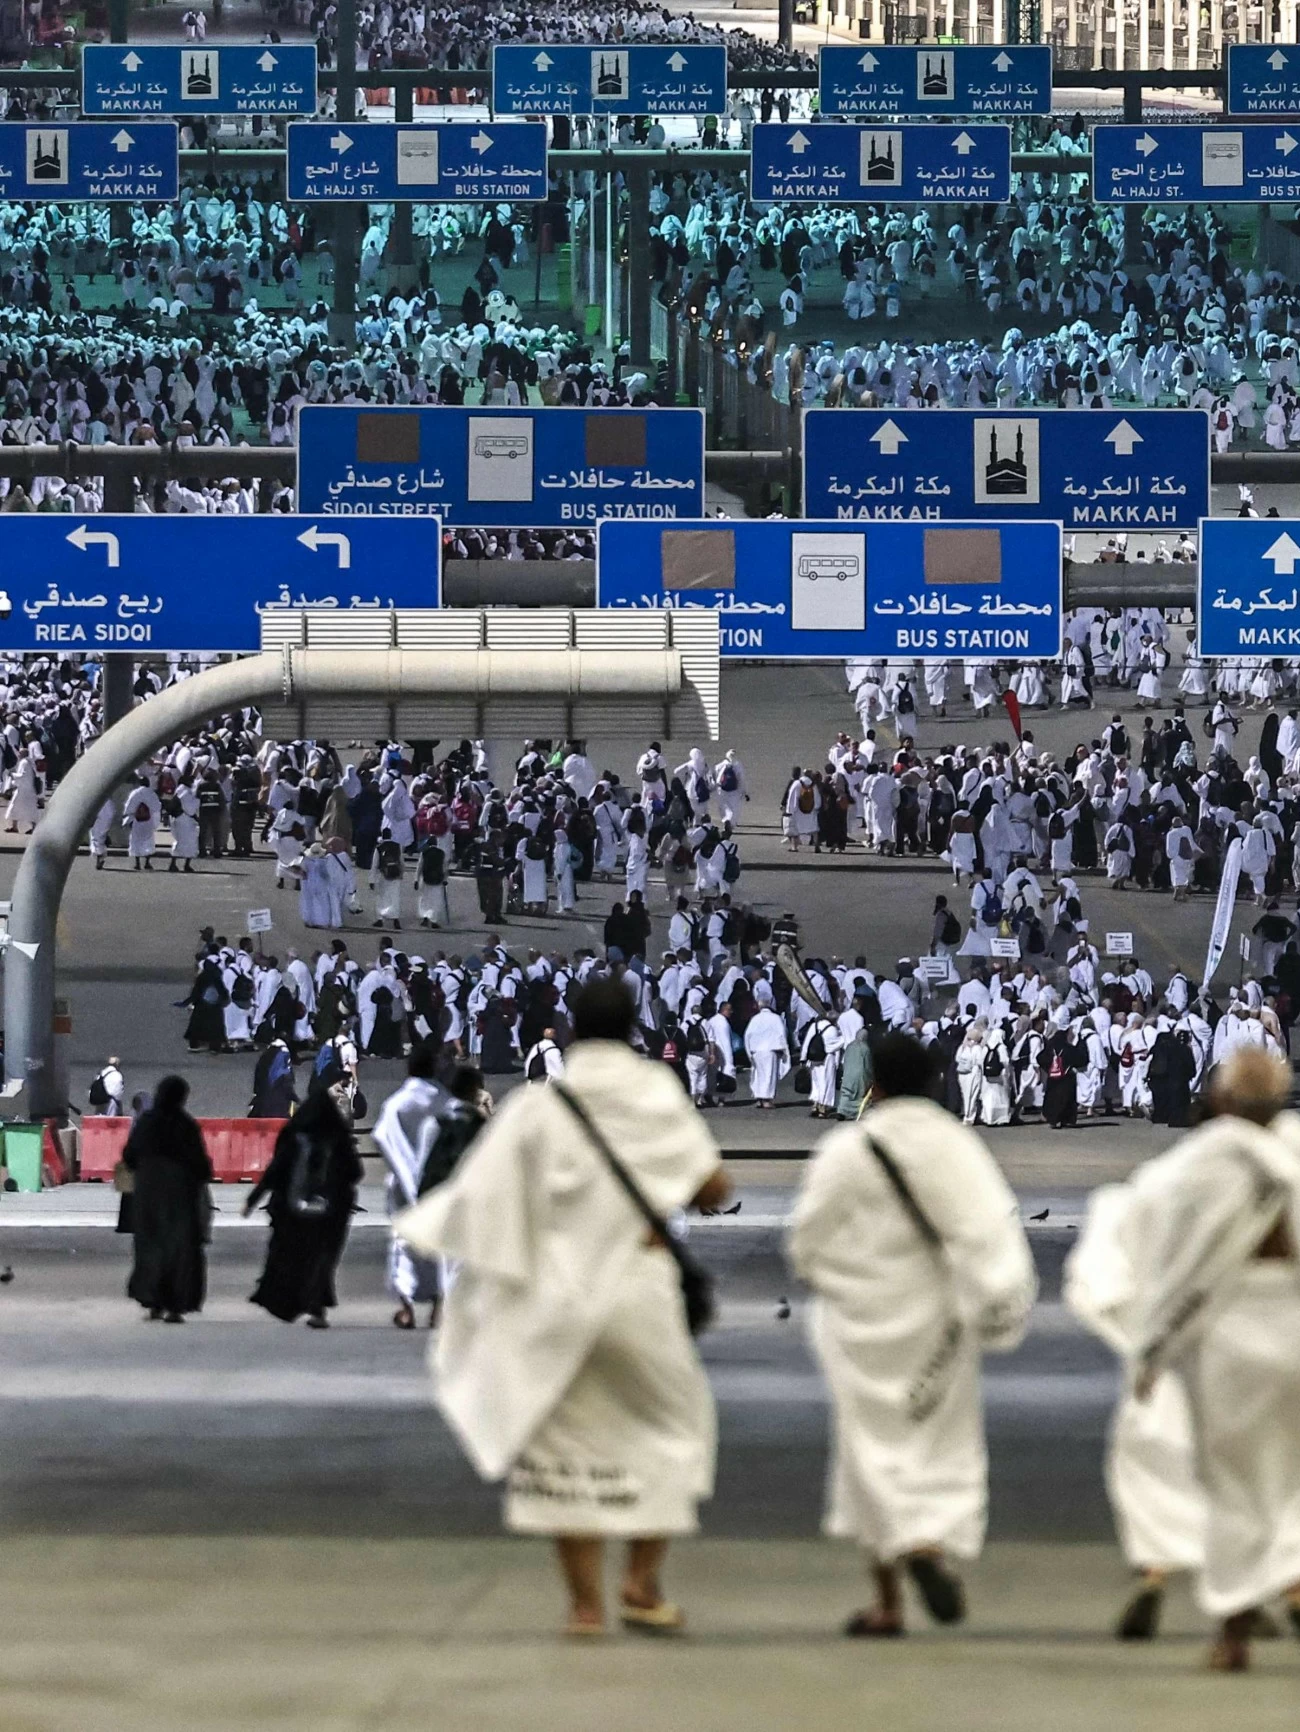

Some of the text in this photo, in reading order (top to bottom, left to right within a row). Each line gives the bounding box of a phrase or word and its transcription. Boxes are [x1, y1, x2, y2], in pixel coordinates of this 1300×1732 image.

[97, 83, 167, 96] مكة المكرمة
[232, 83, 303, 96] مكة المكرمة
[507, 84, 577, 97] مكة المكرمة
[642, 84, 712, 97] مكة المكرمة
[833, 84, 903, 97] مكة المكرمة
[968, 83, 1038, 97] مكة المكرمة
[1243, 83, 1286, 96] المكرمة
[102, 100, 161, 109] MAKKAH
[238, 100, 297, 109] MAKKAH
[513, 100, 571, 111] MAKKAH
[648, 101, 706, 110] MAKKAH
[839, 101, 897, 110] MAKKAH
[973, 100, 1032, 110] MAKKAH
[83, 165, 162, 179] مكة المكرمة
[306, 162, 379, 179] شارع الحج
[442, 164, 542, 176] محطة حافلات
[768, 166, 845, 180] مكة المكرمة
[917, 167, 995, 181] مكة المكرمة
[1112, 163, 1184, 179] شارع الحج
[1248, 165, 1300, 178] حافلات
[90, 184, 156, 194] MAKKAH
[306, 185, 378, 195] AL HAJJ ST.
[456, 185, 529, 194] BUS STATION
[773, 185, 838, 195] MAKKAH
[923, 186, 988, 196] MAKKAH
[1112, 186, 1183, 196] AL HAJJ ST.
[1261, 186, 1283, 196] BUS
[329, 465, 444, 499] شارع صدقي
[541, 469, 695, 489] محطة حافلات
[828, 476, 950, 499] مكة المكرمة
[1064, 476, 1186, 499] مكة المكرمة
[561, 503, 676, 519] BUS STATION
[838, 506, 940, 518] MAKKAH
[1074, 506, 1176, 522] MAKKAH
[23, 583, 107, 619] صدقي
[713, 593, 785, 616] محطة
[874, 592, 1052, 615] محطة حافلات
[36, 624, 151, 641] RIEA SIDQI
[719, 629, 762, 648] TION
[897, 630, 1028, 647] BUS STATION
